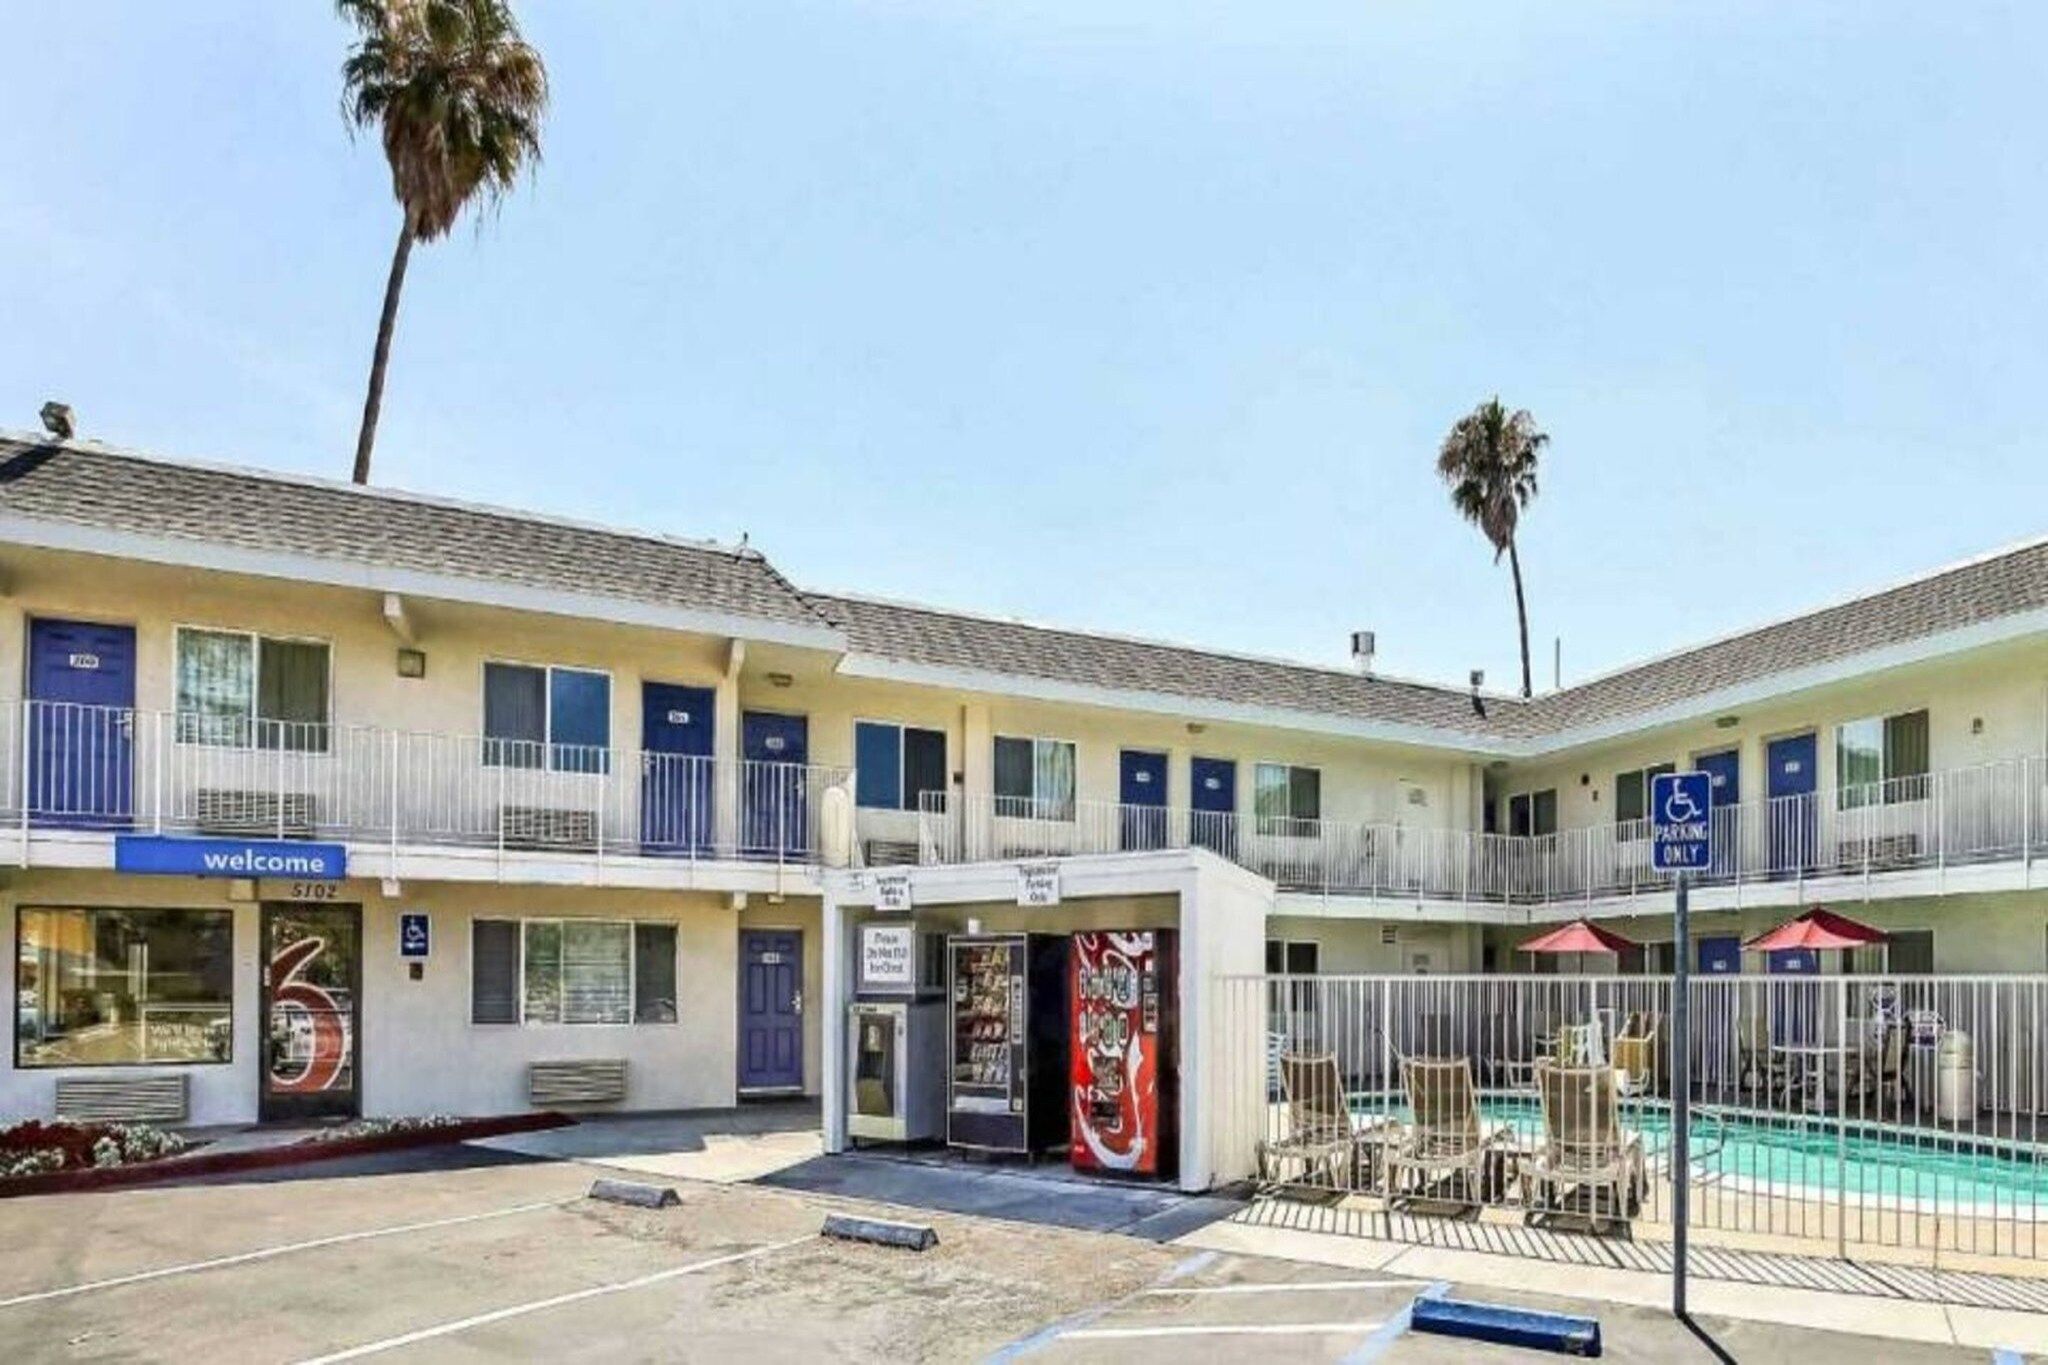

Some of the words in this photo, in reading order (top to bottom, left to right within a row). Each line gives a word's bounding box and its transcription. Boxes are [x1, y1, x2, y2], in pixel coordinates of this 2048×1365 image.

[1654, 822, 1707, 842] PARKING
[203, 849, 325, 873] welcome
[1663, 844, 1699, 863] ONLY
[290, 882, 337, 899] 5102
